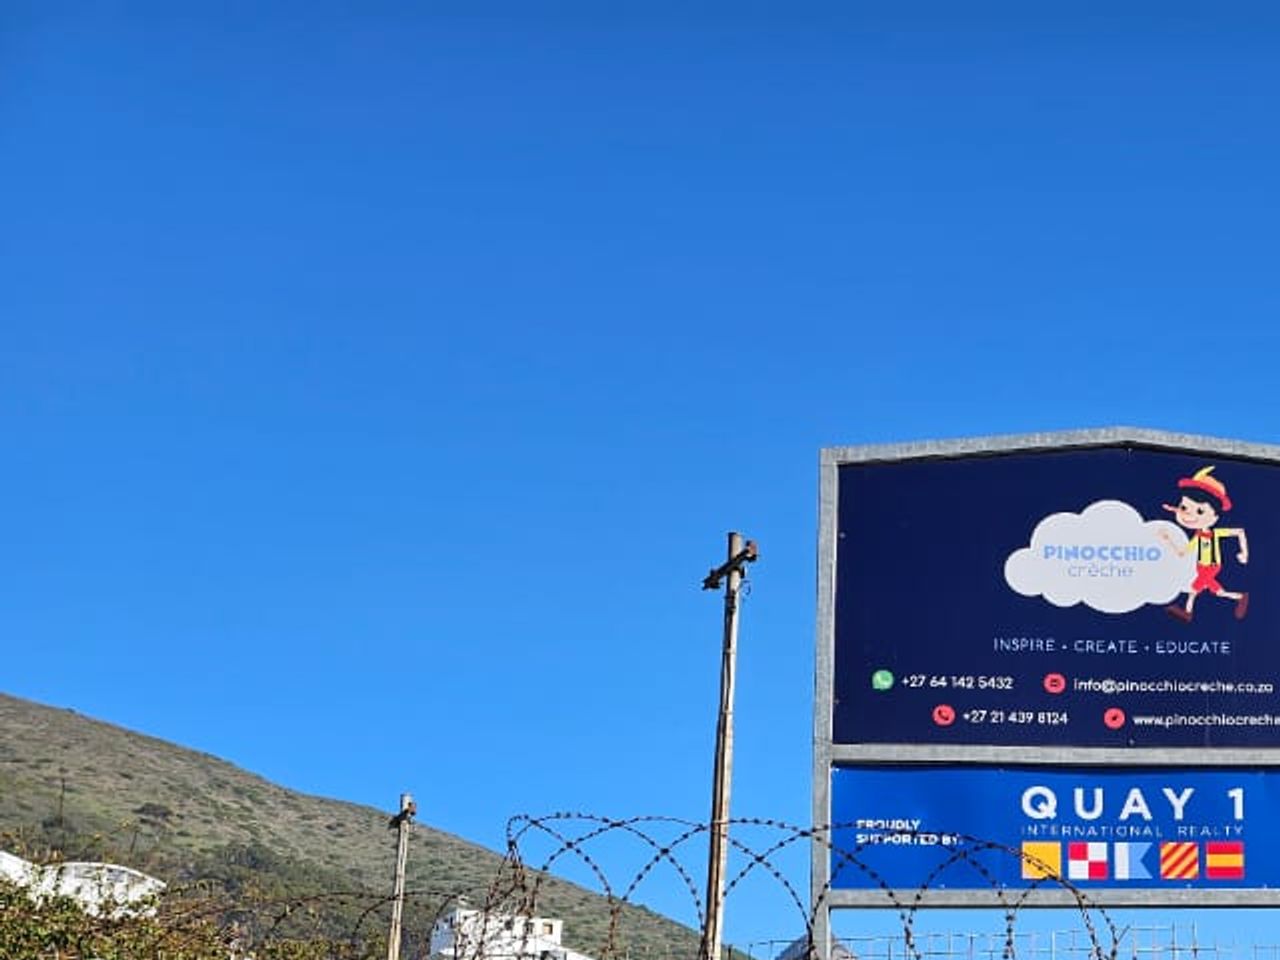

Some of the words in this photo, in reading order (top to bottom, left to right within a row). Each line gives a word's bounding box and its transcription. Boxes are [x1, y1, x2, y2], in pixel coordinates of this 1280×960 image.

[1043, 545, 1162, 562] PINOCCHIO
[1067, 562, 1134, 578] crèche
[993, 637, 1056, 652] INSPIRE
[1073, 639, 1138, 654] CREATE
[1155, 641, 1232, 655] EDUCATE
[902, 675, 926, 688] +27
[952, 676, 974, 689] 142
[978, 676, 1014, 690] 5432
[1073, 677, 1274, 694] info@pinocchiocreche.co.za
[962, 710, 987, 723] +27
[990, 711, 1004, 723] 21
[1021, 785, 1195, 821] QUAY
[1227, 788, 1244, 820] 1
[1021, 824, 1163, 838] INTERNATIONAL
[1178, 825, 1244, 837] REALTY
